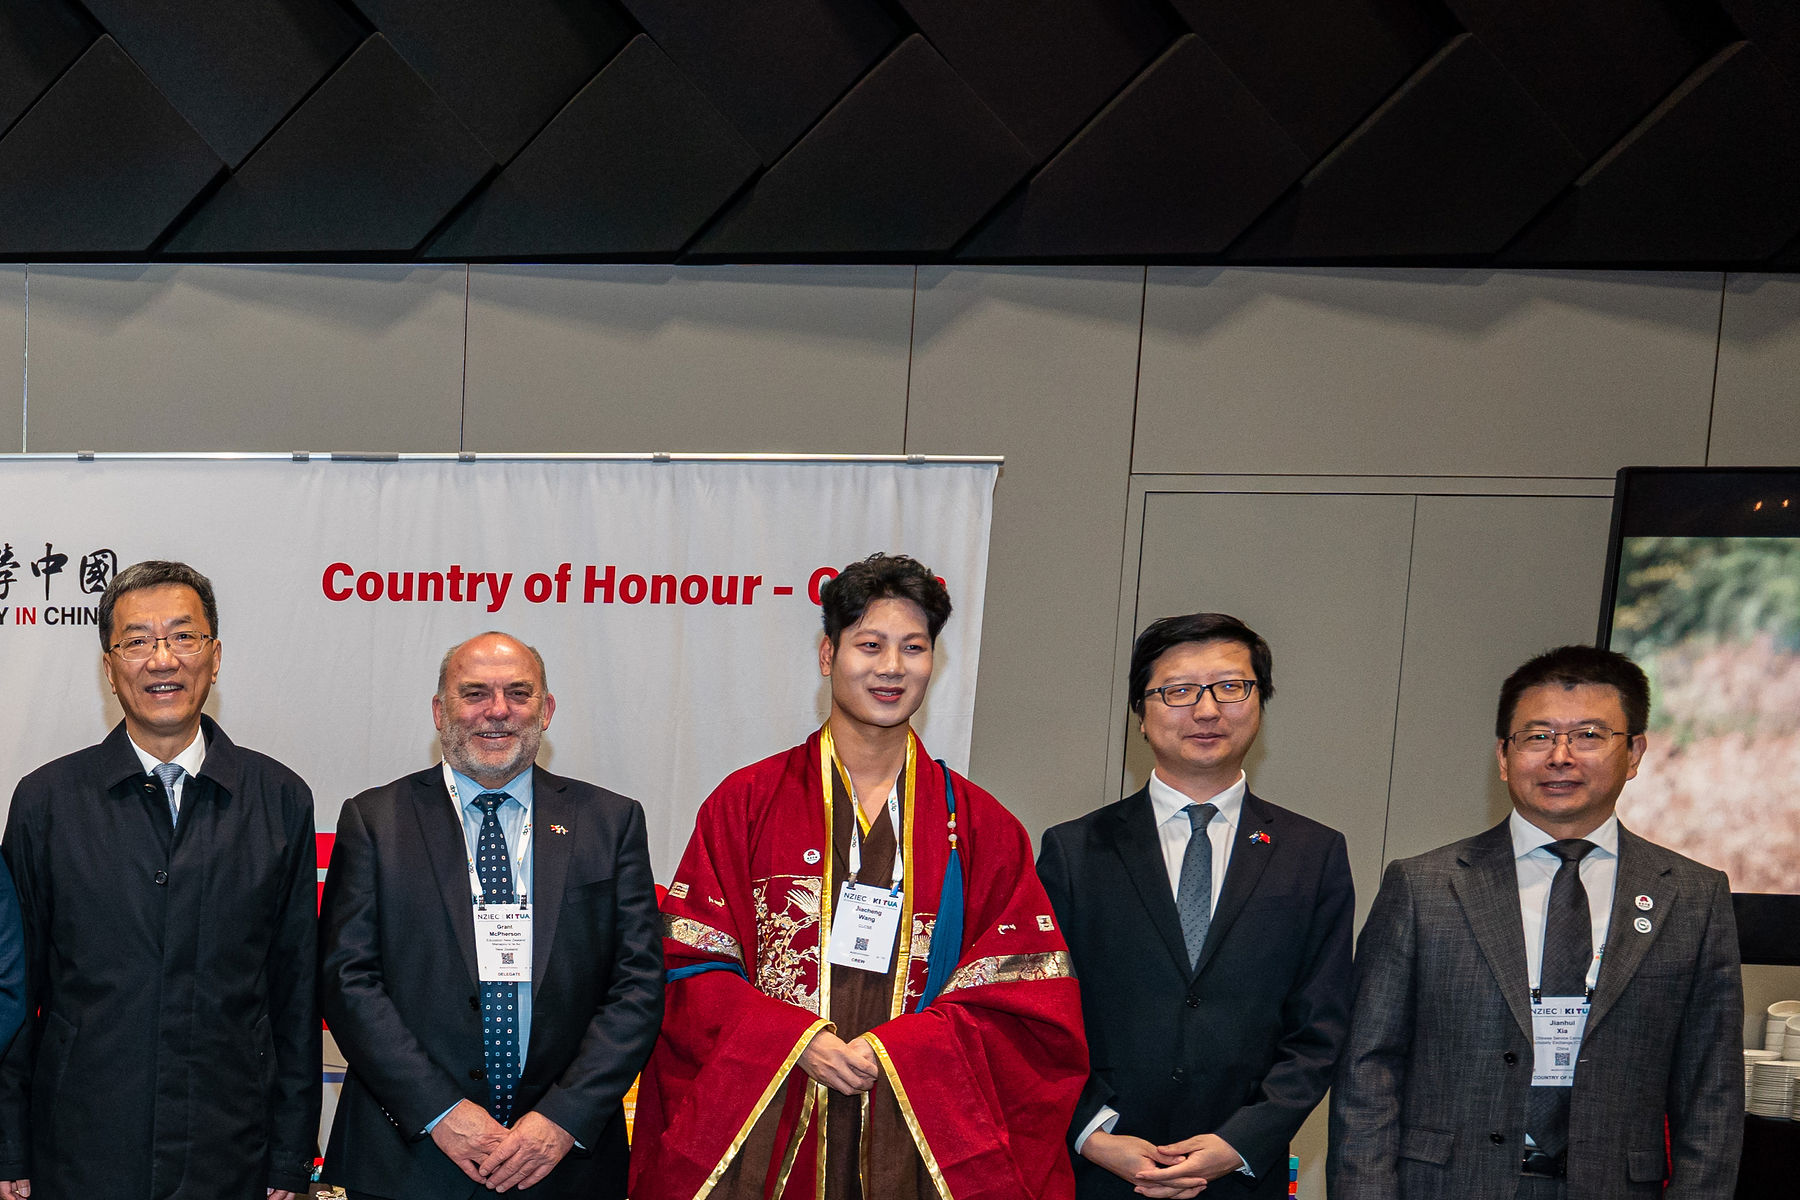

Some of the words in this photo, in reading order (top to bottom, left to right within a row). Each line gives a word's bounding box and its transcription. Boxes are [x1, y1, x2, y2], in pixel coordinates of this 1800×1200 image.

[322, 562, 513, 613] Country
[523, 563, 572, 604] of
[583, 565, 762, 606] Honour
[16, 607, 36, 625] IN
[44, 606, 99, 626] CHIN
[843, 892, 867, 902] NZIEC
[872, 897, 882, 905] KI
[883, 899, 898, 908] TUA
[856, 906, 882, 916] Jiacheng
[858, 914, 875, 923] Wang
